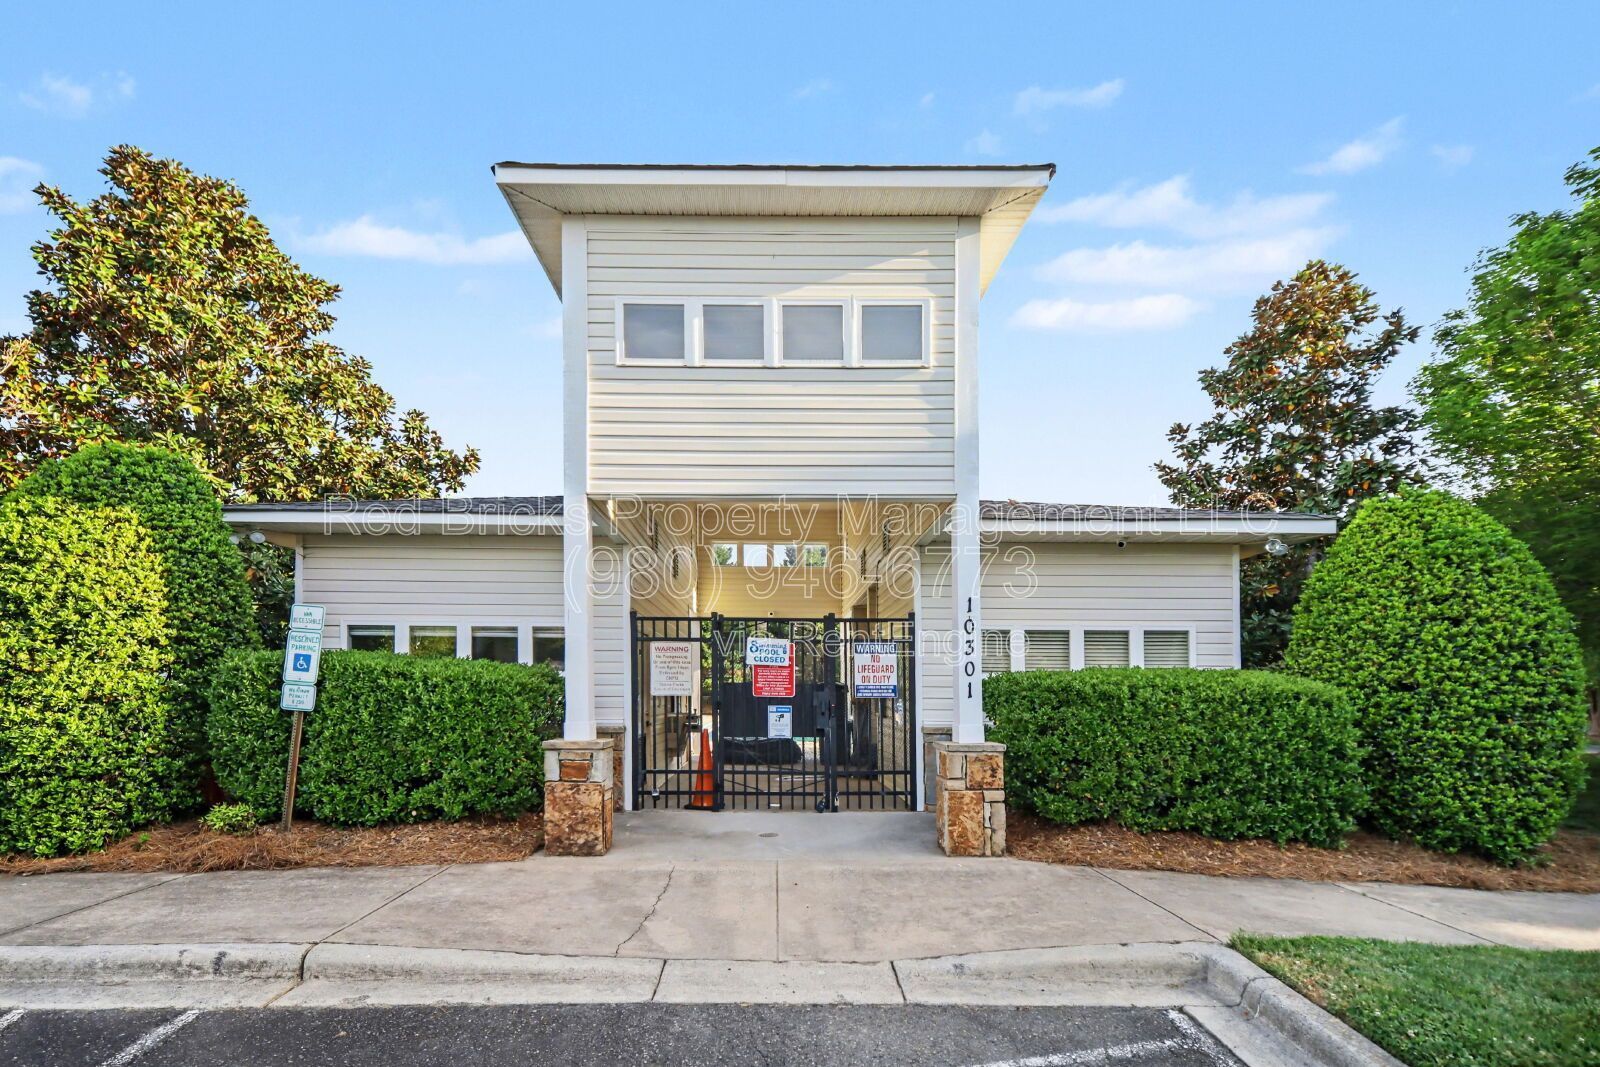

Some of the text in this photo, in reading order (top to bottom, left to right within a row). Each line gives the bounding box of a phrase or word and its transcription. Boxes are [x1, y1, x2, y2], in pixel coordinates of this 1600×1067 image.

[291, 635, 320, 643] RESERVED
[291, 644, 317, 652] PARKING
[759, 648, 781, 656] POOL
[856, 644, 895, 653] WARNING
[963, 597, 975, 699] 10301
[753, 655, 786, 663] CLOSED
[870, 654, 881, 663] NO
[857, 664, 895, 673] LIFEGUARD
[861, 675, 891, 684] ON DUTY
